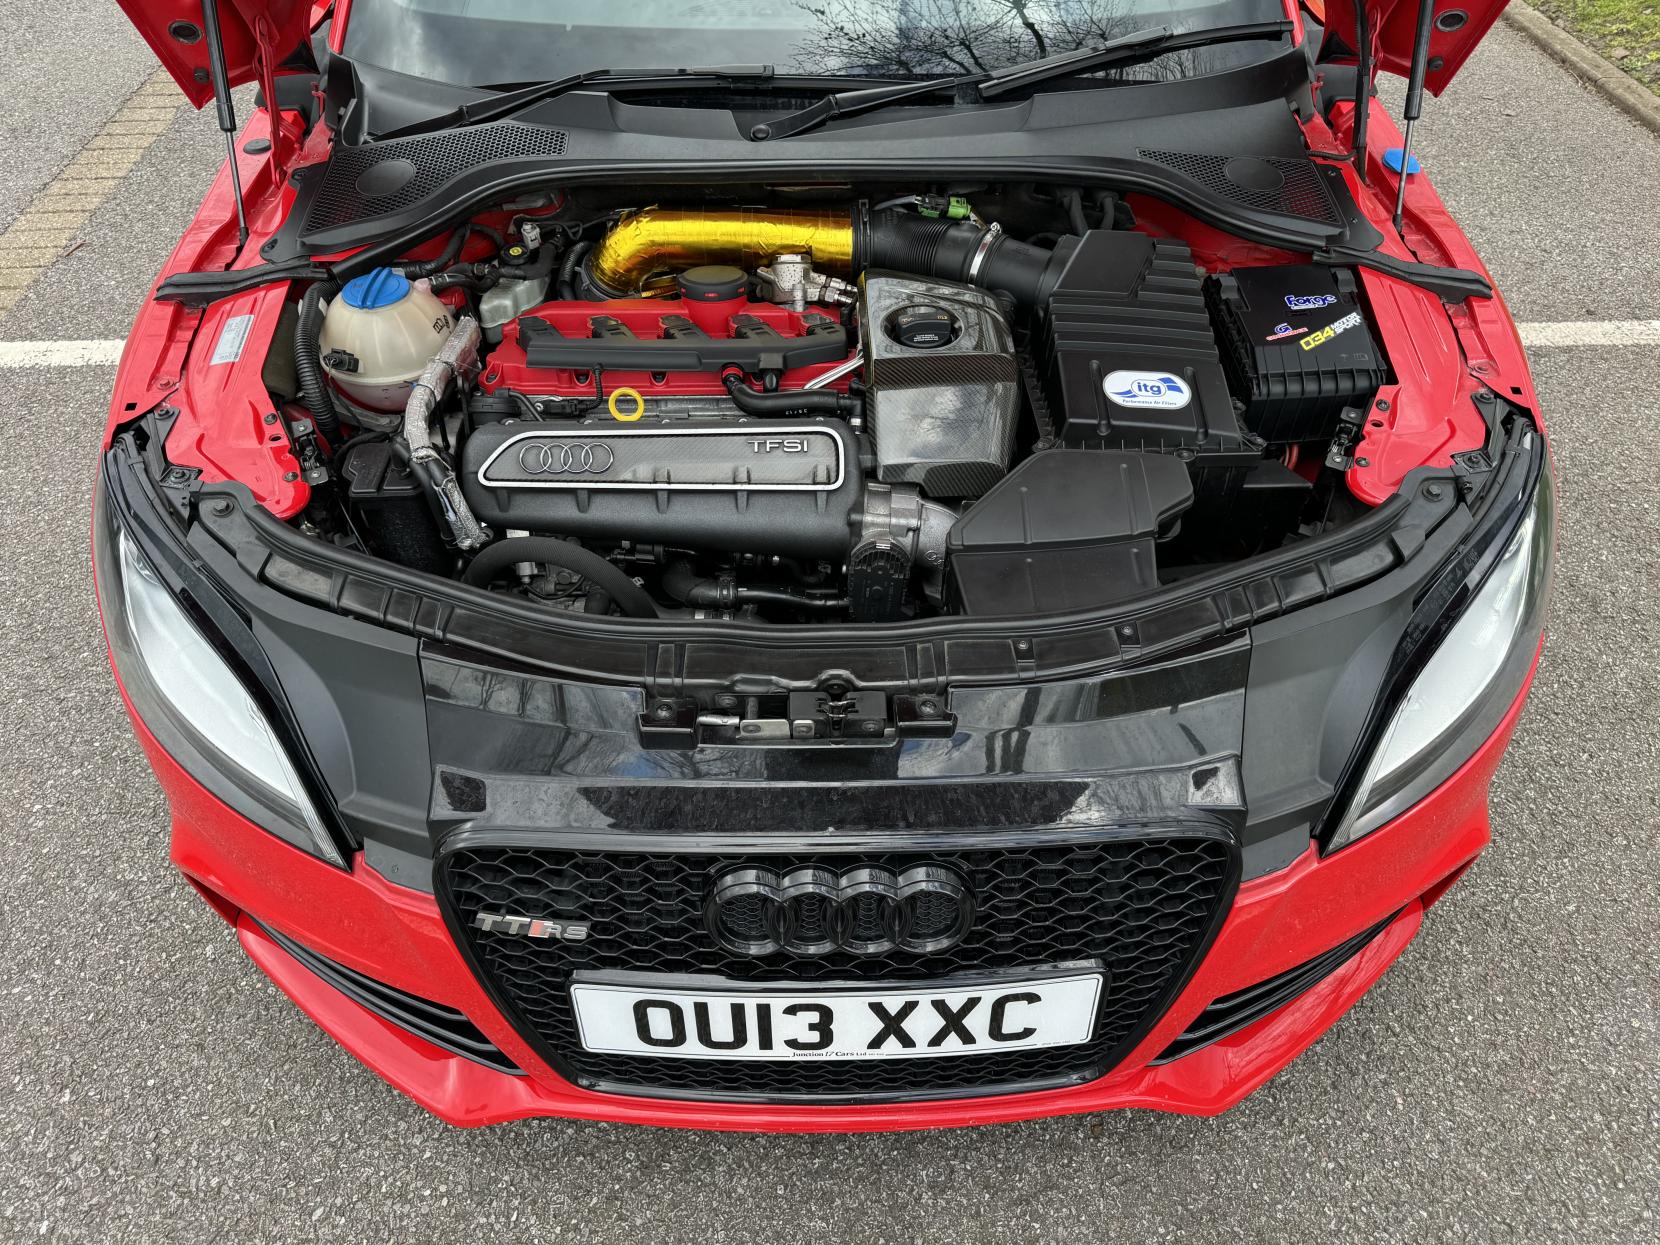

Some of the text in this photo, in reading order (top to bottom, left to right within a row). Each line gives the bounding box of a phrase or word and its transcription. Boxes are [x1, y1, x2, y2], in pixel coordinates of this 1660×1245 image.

[1285, 295, 1337, 308] Forge
[1300, 326, 1335, 351] 034
[1331, 312, 1360, 330] MOTOR
[1137, 382, 1162, 396] itg
[747, 439, 809, 453] TFSI
[632, 992, 1042, 1051] OU13 XXC
